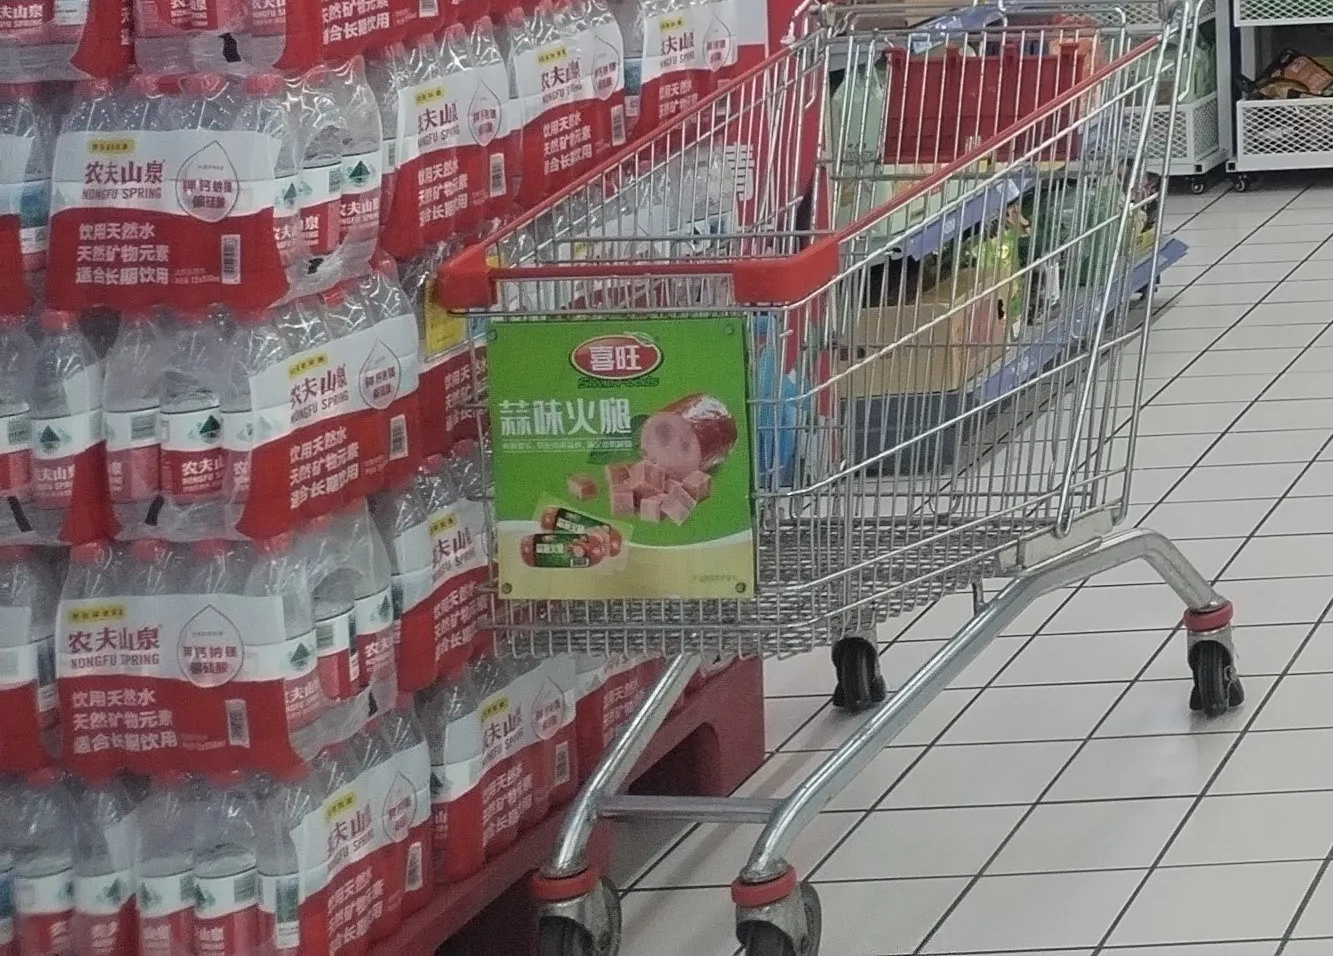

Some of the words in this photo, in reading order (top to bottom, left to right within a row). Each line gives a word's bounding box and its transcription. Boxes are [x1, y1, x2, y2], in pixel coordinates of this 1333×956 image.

[84, 159, 164, 186] 农夫山泉
[81, 188, 118, 201] NONGFU
[122, 187, 163, 200] SPRING
[79, 222, 156, 242] 饮用天然水
[76, 244, 170, 263] 天然矿物元素
[76, 266, 170, 285] 适合长期饮用
[589, 344, 642, 372] 喜旺
[499, 397, 632, 436] 蒜味火腿
[68, 625, 162, 655] 农夫山泉
[70, 653, 117, 670] NONGFU
[120, 652, 160, 667] SPRING
[72, 687, 157, 709] 饮用天然水
[73, 709, 174, 733] 天然矿物元素
